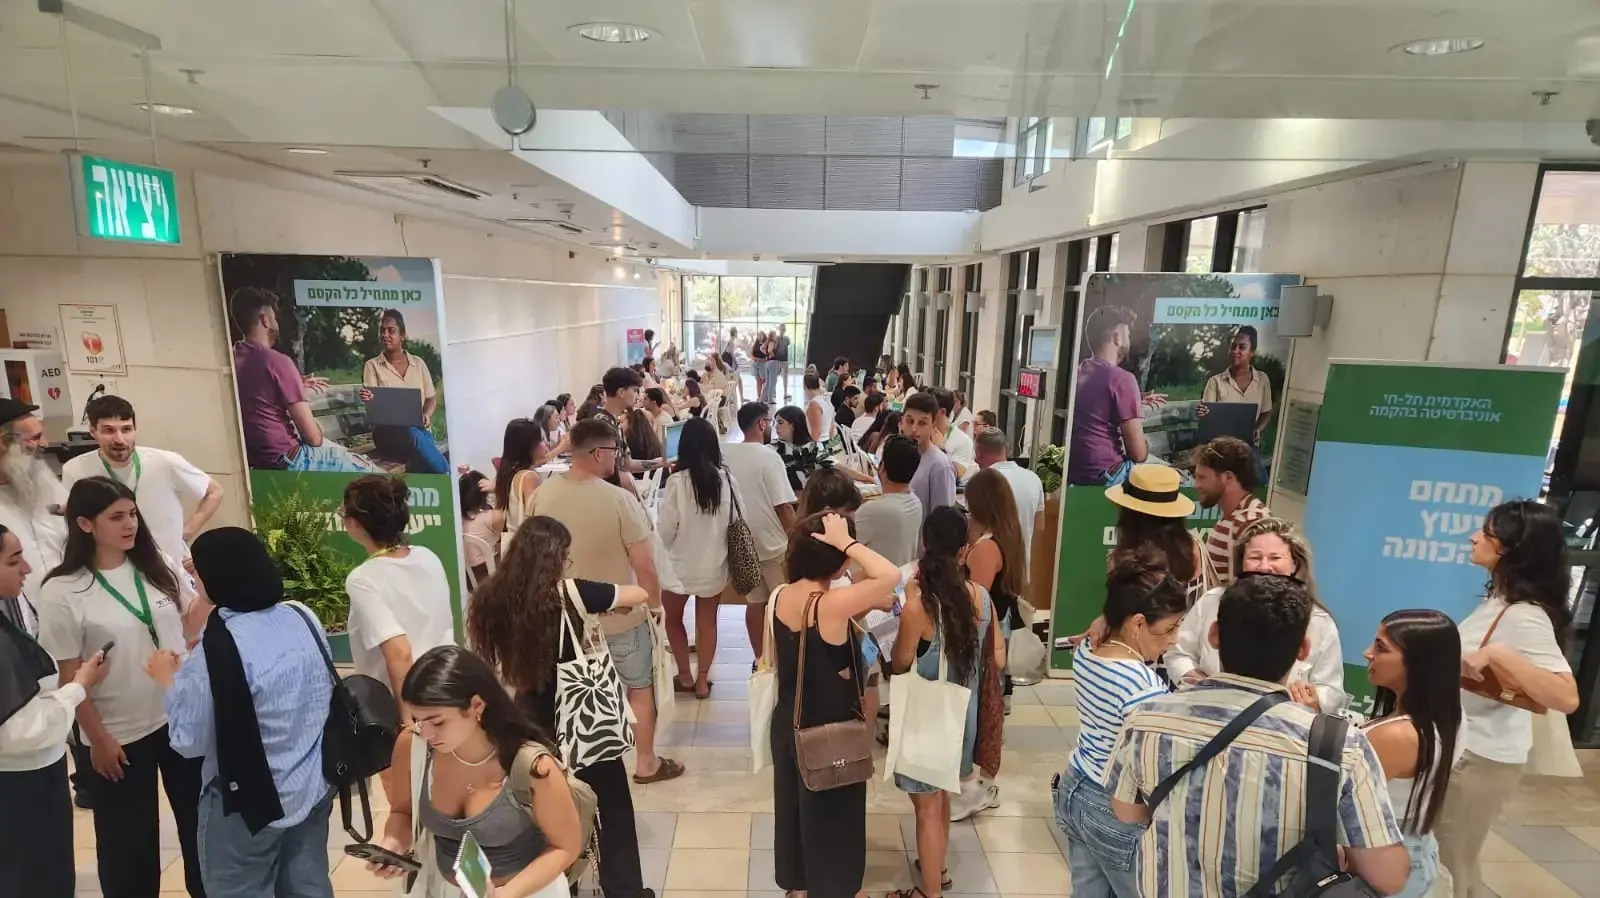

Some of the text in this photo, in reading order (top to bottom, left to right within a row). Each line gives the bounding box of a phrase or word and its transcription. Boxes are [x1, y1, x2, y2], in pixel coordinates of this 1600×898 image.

[307, 286, 422, 304] כאן מתחיל כל הקסם
[1166, 305, 1201, 319] הקסם
[1204, 303, 1218, 318] כל
[1220, 304, 1259, 318] מתחיל
[86, 356, 99, 364] 101
[41, 367, 61, 378] AED
[1384, 393, 1492, 409] האקדמית תל-חי
[1369, 405, 1502, 422] אוניברסיטה בהקמה
[1409, 480, 1503, 508] מתחם
[1421, 509, 1486, 539] יעוץ
